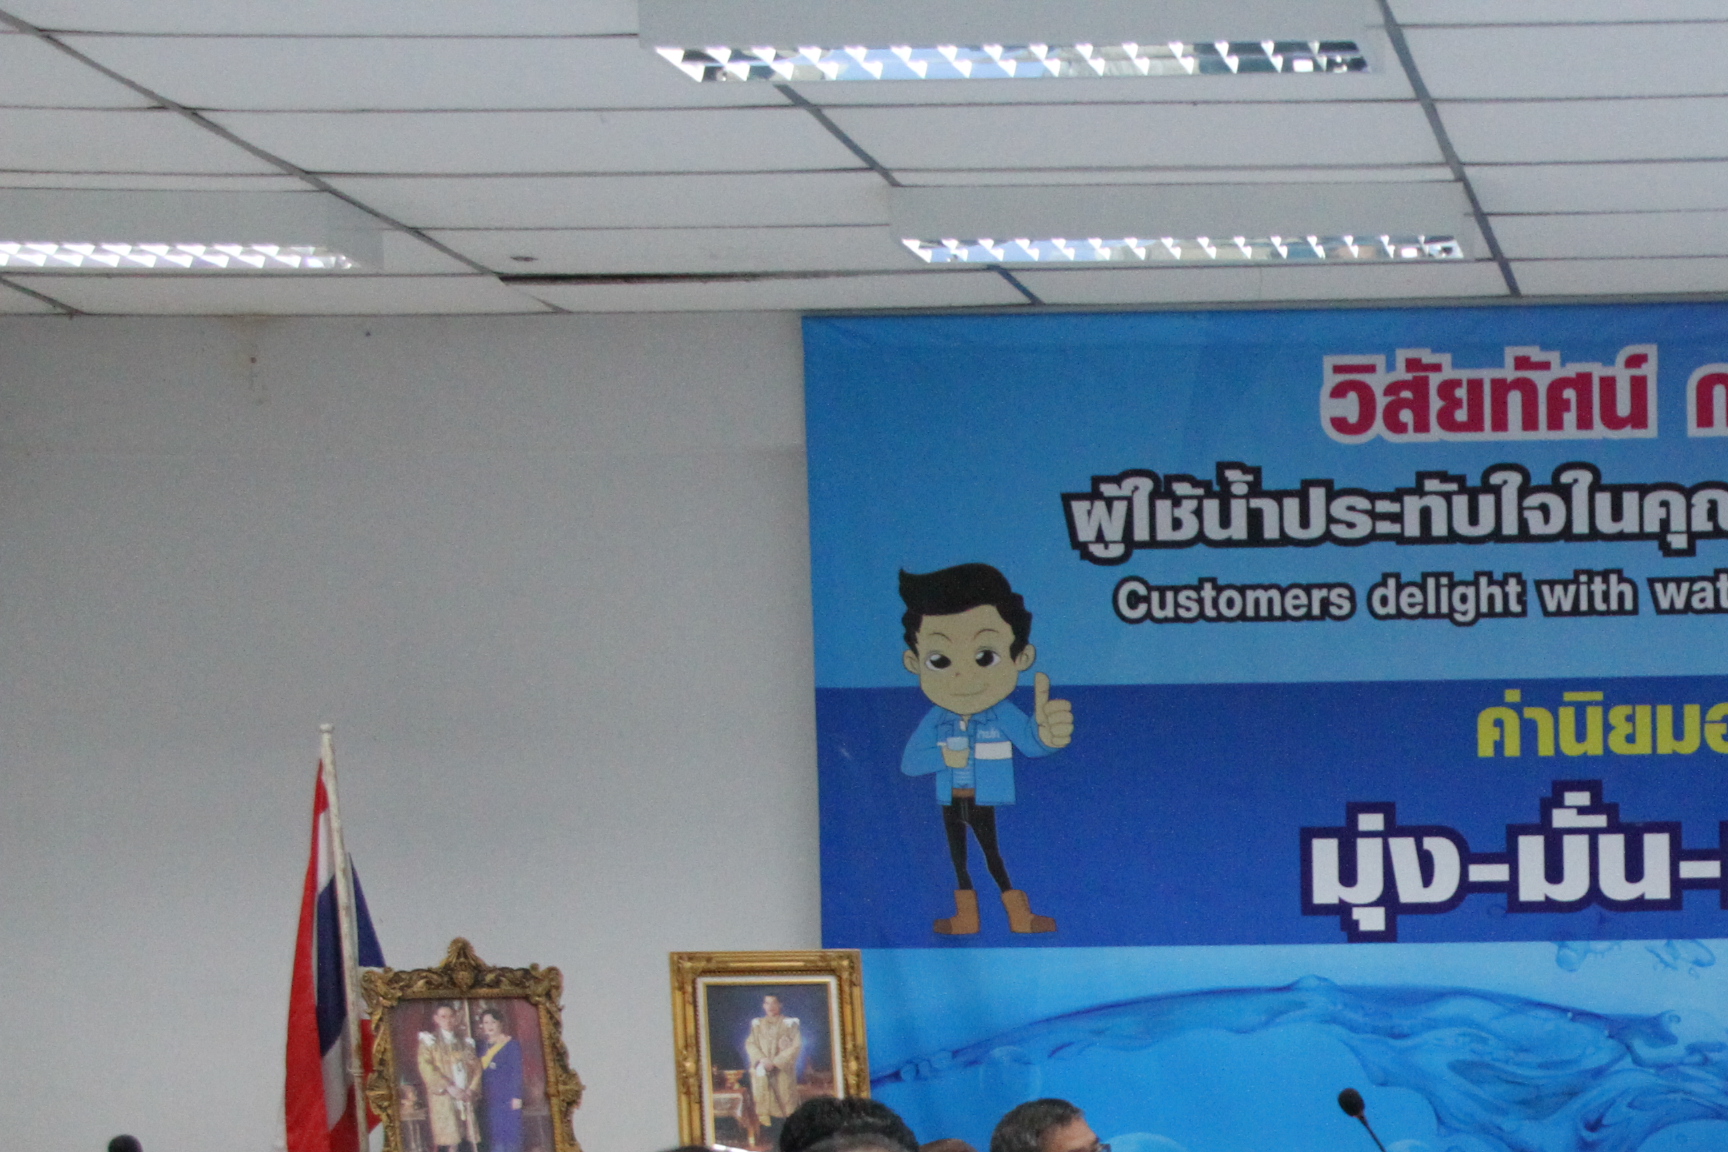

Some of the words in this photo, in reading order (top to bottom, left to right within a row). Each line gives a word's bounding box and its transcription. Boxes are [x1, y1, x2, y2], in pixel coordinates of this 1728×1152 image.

[1328, 350, 1650, 437] วิสัยทัศน์
[1115, 579, 1351, 618] Customers
[1374, 578, 1523, 622] delight
[1541, 574, 1634, 613] with
